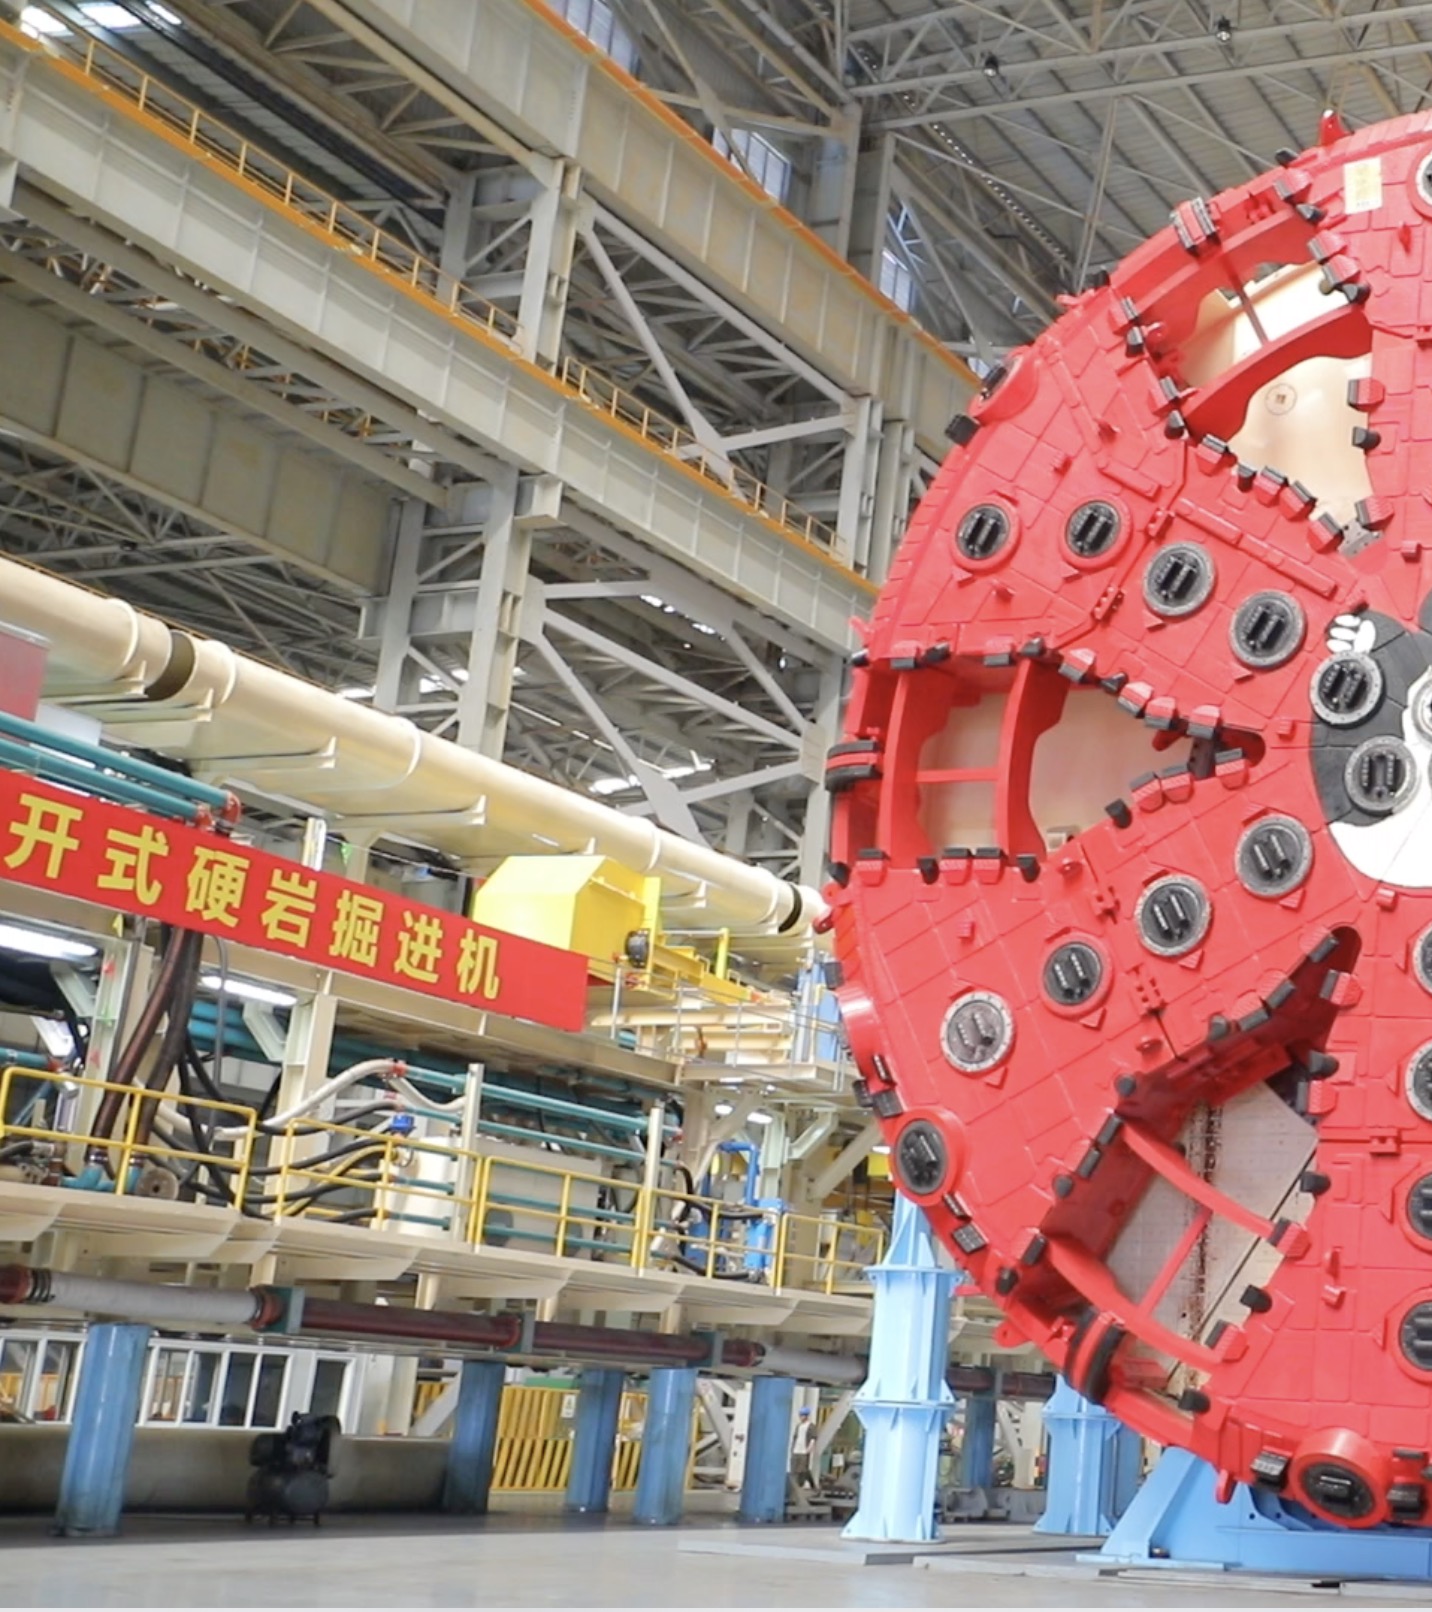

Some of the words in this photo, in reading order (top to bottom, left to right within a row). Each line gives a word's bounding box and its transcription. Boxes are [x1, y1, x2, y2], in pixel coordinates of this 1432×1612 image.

[4, 793, 500, 999] 开式硬岩掘进机
